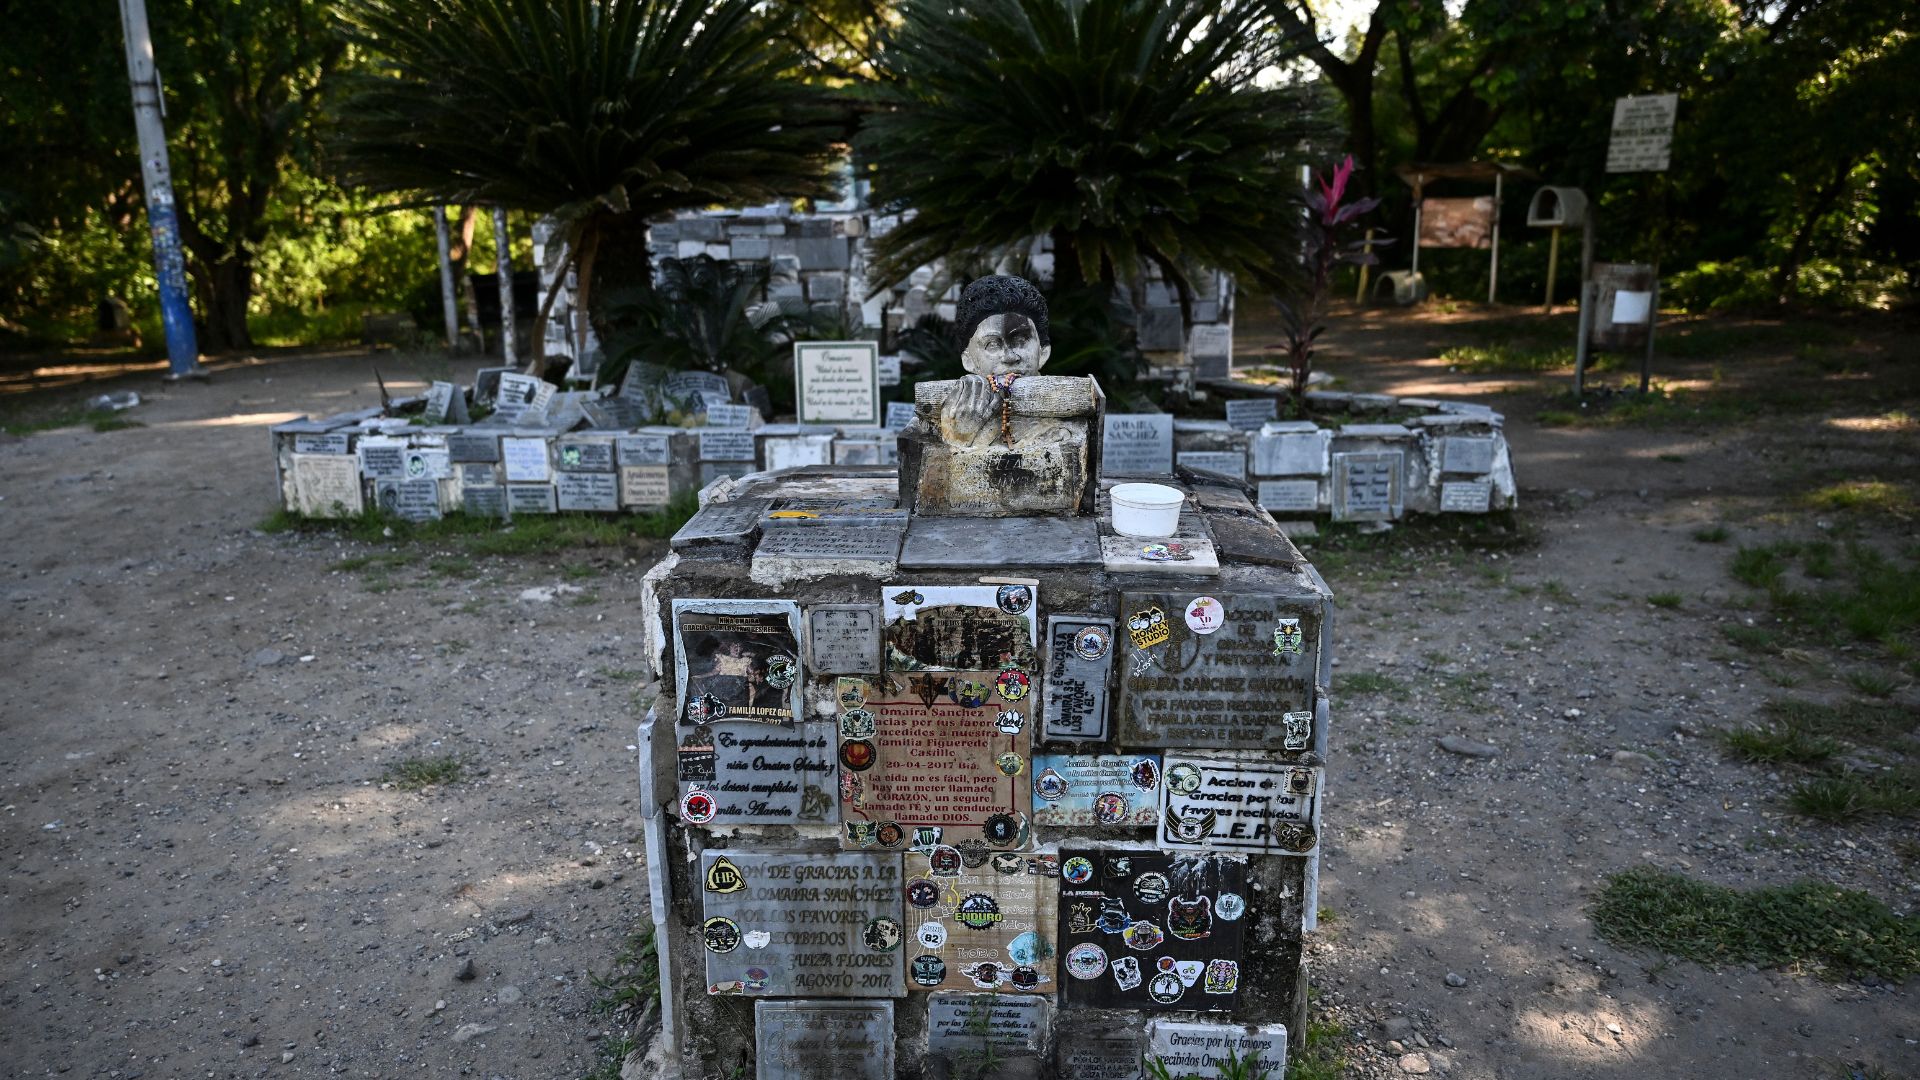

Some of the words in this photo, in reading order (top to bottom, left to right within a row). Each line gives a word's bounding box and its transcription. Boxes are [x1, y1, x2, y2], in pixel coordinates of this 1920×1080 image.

[1131, 621, 1169, 641] MONKEY
[1137, 629, 1170, 646] STUDIO
[1183, 677, 1245, 692] SANCHEZ
[728, 706, 756, 716] FAMILIA
[757, 707, 776, 716] LOPEZ
[880, 708, 927, 717] Omaira
[931, 708, 985, 717] Sanchez
[874, 719, 907, 727] acias
[911, 720, 932, 728] por
[959, 718, 997, 727] favor
[875, 728, 935, 737] oncedidos
[951, 729, 999, 737] nuestra
[718, 731, 738, 748] En
[739, 735, 807, 752] agradecimiento
[807, 739, 816, 747] a
[816, 736, 828, 747] la
[878, 738, 922, 747] familia
[927, 738, 988, 748] Figueredo
[910, 748, 956, 757] Castillo
[726, 759, 749, 770] niña
[752, 755, 791, 771] Omaira
[793, 756, 835, 777] Sánchz
[886, 761, 954, 769] 20-04-2017
[868, 774, 882, 782] La
[885, 773, 908, 782] vida
[973, 775, 998, 784] pero
[1208, 776, 1256, 788] Accion
[708, 780, 719, 792] los
[721, 780, 749, 792] deseos
[752, 781, 798, 797] cumplidos
[872, 783, 892, 793] hay
[896, 784, 911, 792] un
[914, 784, 946, 792] motor
[949, 783, 994, 793] llamado
[876, 792, 931, 802] CORAZÓN,
[953, 795, 990, 803] seguro
[1188, 790, 1243, 803] Gracias
[1246, 794, 1272, 806] por
[744, 800, 792, 816] Alarcón
[864, 802, 906, 811] lamado
[924, 804, 931, 813] y
[934, 804, 949, 812] un
[952, 803, 1006, 812] conductor
[894, 812, 939, 821] llamado
[942, 813, 973, 822] DIOS.
[1235, 808, 1300, 820] recibidos
[714, 872, 735, 885] HB
[768, 865, 791, 879] DE
[794, 865, 859, 884] GRACIAS
[862, 865, 875, 880] A
[876, 865, 897, 880] LA
[756, 887, 822, 902] OMAIRA
[823, 883, 896, 902] SANCHEZ
[769, 909, 796, 924] LOS
[799, 909, 868, 924] FAVORES
[954, 912, 1003, 923] ENDURO
[770, 931, 846, 946] ECIBIDOS
[924, 933, 939, 943] 82
[836, 954, 895, 968] FLORES
[938, 998, 949, 1006] En
[990, 1009, 1021, 1018] ánchez
[1170, 1032, 1205, 1047] Gracias
[1205, 1038, 1223, 1050] por
[1224, 1034, 1236, 1048] los
[1236, 1035, 1272, 1052] favores
[1160, 1051, 1200, 1067] recibidos
[1201, 1053, 1239, 1068] Omir
[1241, 1055, 1280, 1072] Schez
